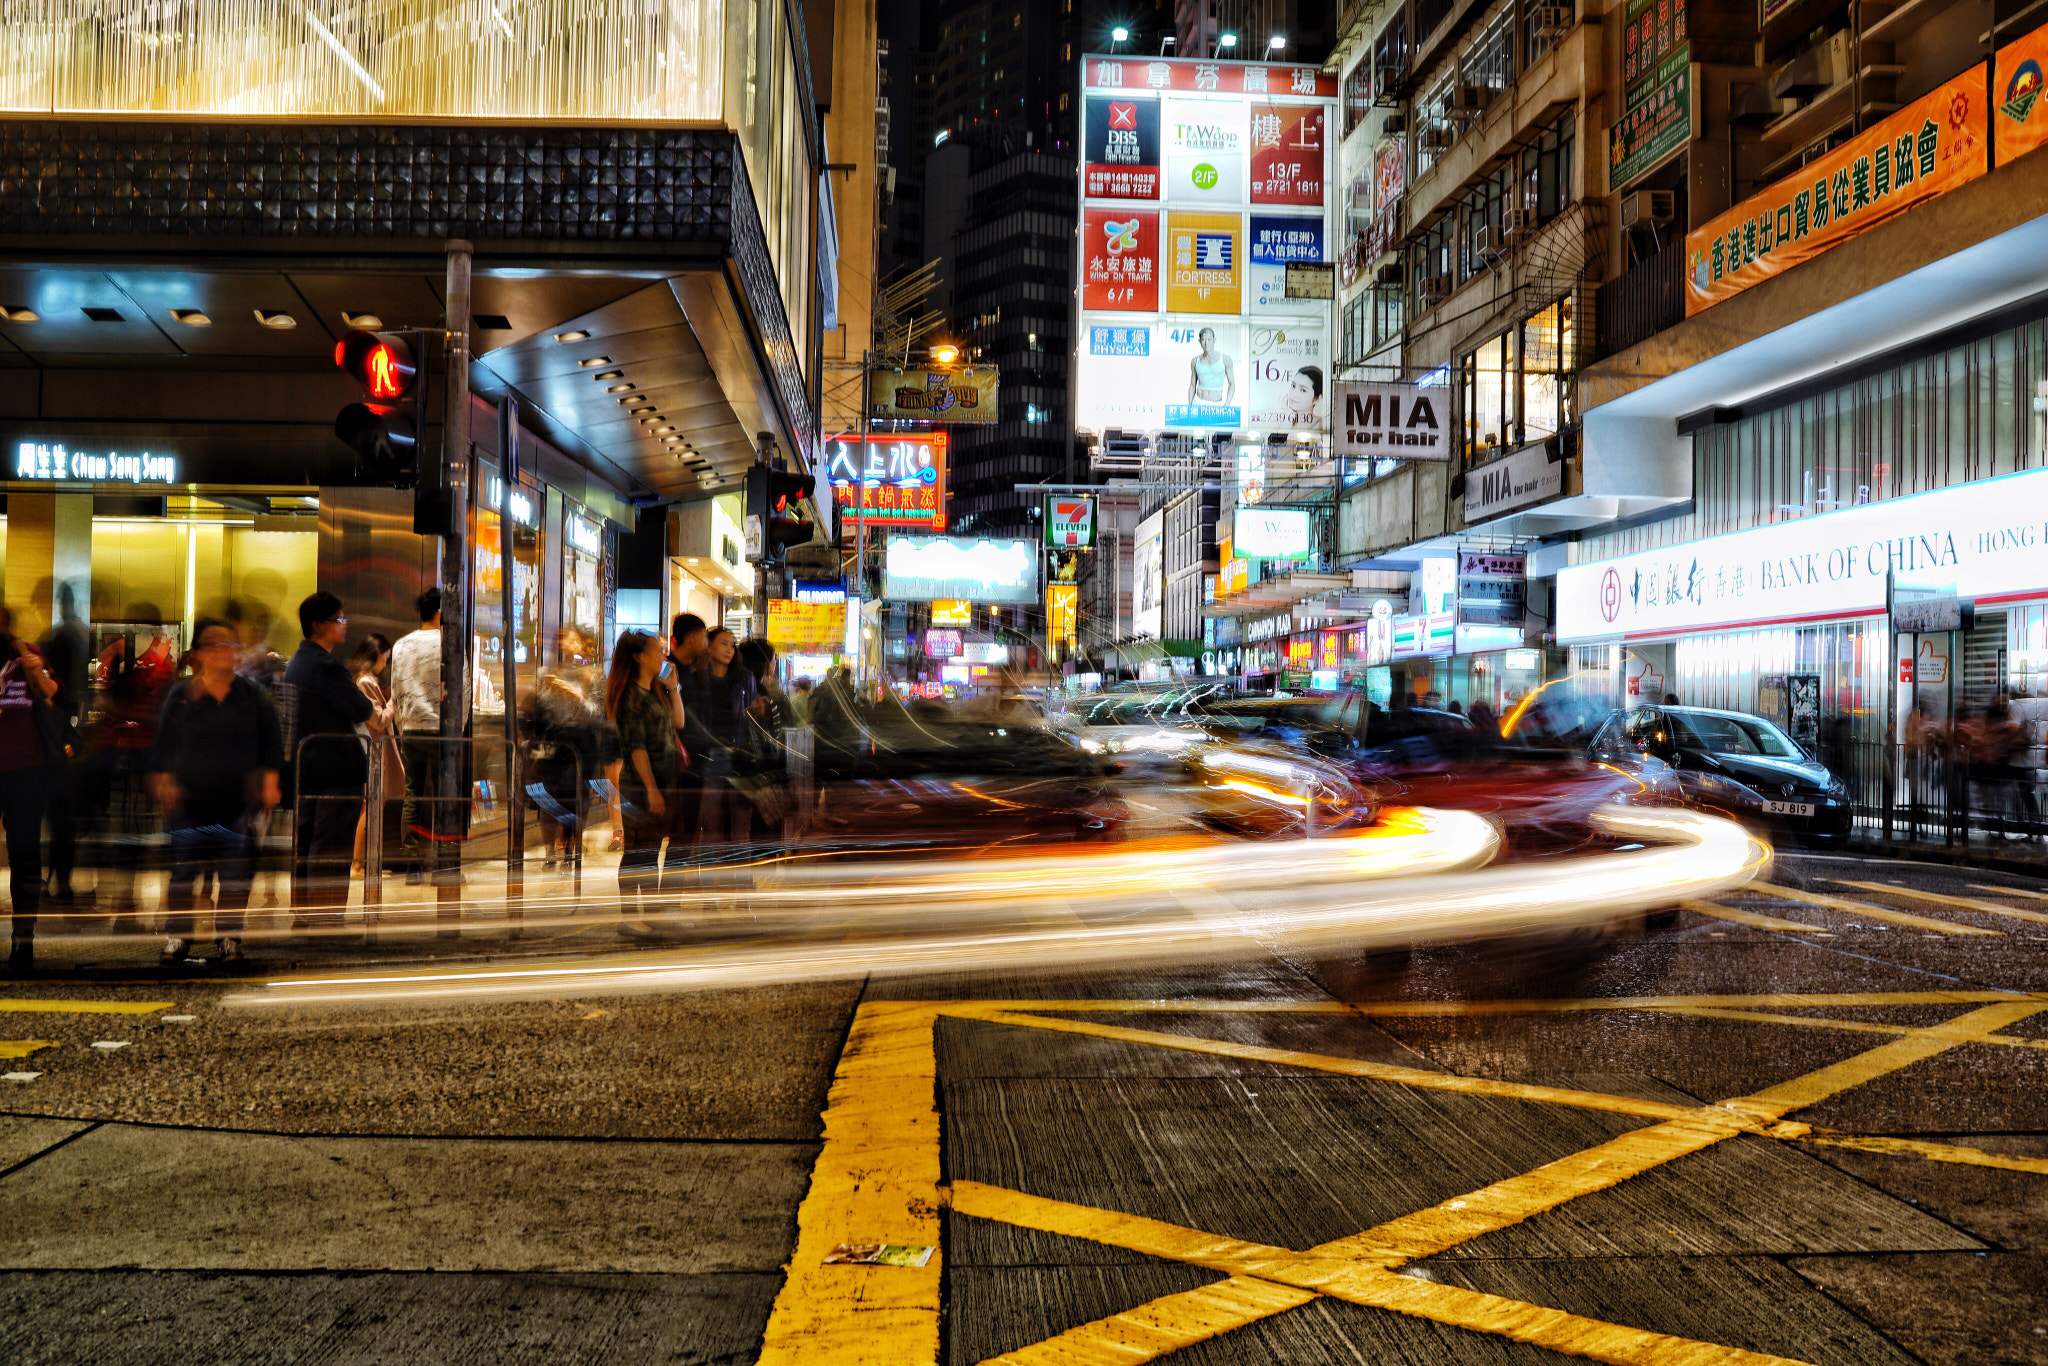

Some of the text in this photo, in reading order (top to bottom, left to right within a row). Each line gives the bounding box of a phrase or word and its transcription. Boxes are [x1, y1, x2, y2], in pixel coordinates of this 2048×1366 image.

[1097, 60, 1317, 95] 加拿芬廣場
[1108, 130, 1138, 145] DBS
[1251, 113, 1319, 150] 樓上
[1194, 170, 1216, 183] 2/F
[1268, 162, 1301, 178] 13/F
[1266, 180, 1319, 192] 2721 1611
[1711, 118, 1940, 283] 香港進出口貿易從業員協會
[1090, 255, 1152, 272] 永安旅遊
[1090, 271, 1152, 281] WING ON TRAVEL
[1176, 271, 1232, 284] FORTRESS
[1198, 288, 1211, 299] 1F
[1170, 329, 1195, 343] 4/F
[1094, 345, 1146, 356] PHYSICAL
[1276, 346, 1303, 356] beauty
[1252, 359, 1293, 382] 16/F
[1260, 412, 1313, 423] 2739 6130
[1346, 393, 1439, 429] MIA
[1346, 429, 1439, 446] for hair
[17, 443, 67, 478] 周生生
[71, 451, 174, 484] Chow Sang Sang
[1482, 466, 1512, 506] MIA
[1514, 485, 1523, 496] for
[1524, 479, 1539, 493] hair
[1762, 552, 1820, 590] BANK
[1828, 546, 1859, 581] OF
[1867, 530, 1959, 576] CHINA
[1480, 583, 1520, 592] STYLE
[1770, 802, 1807, 814] SJ 819
